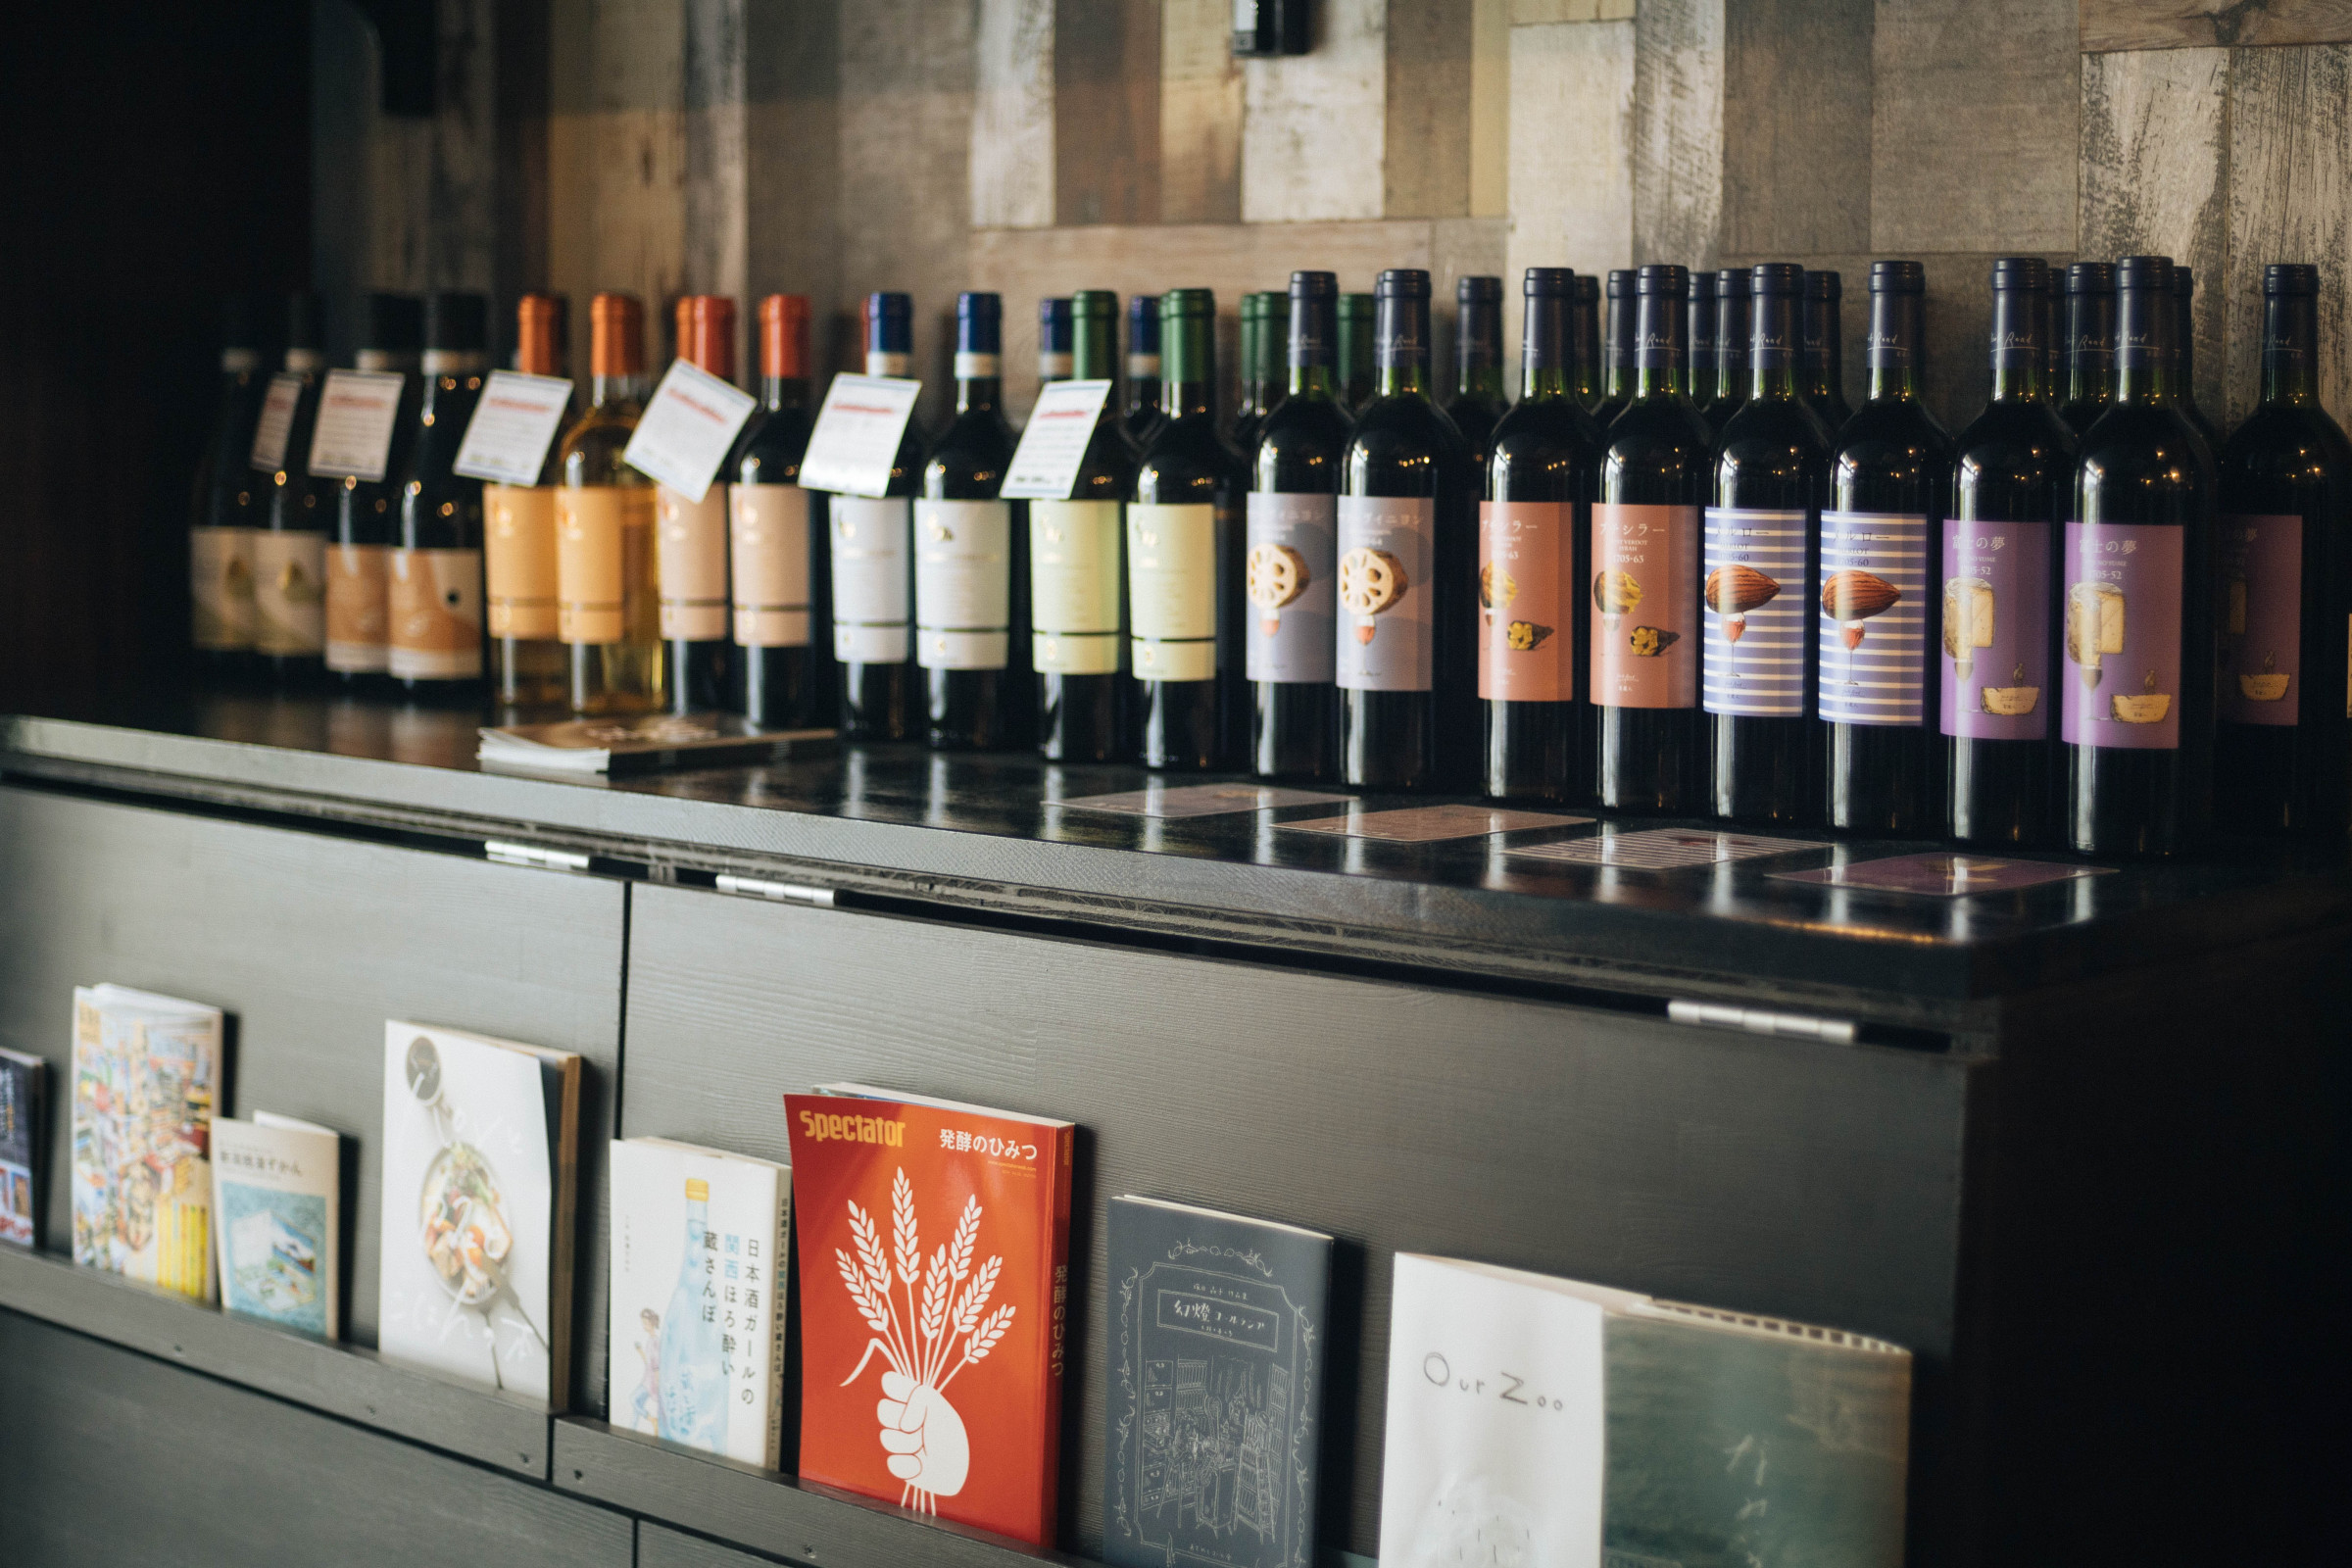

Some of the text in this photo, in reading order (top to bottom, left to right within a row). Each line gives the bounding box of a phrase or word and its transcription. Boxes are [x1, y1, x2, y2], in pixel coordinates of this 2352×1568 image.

[799, 1110, 906, 1149] Spectator
[939, 1128, 1038, 1160] 発酵のひみつ
[740, 1239, 760, 1405] 日本酒ガールの
[1052, 1264, 1068, 1376] 発酵のひみつ
[1423, 1351, 1564, 1411] Our Zoo
